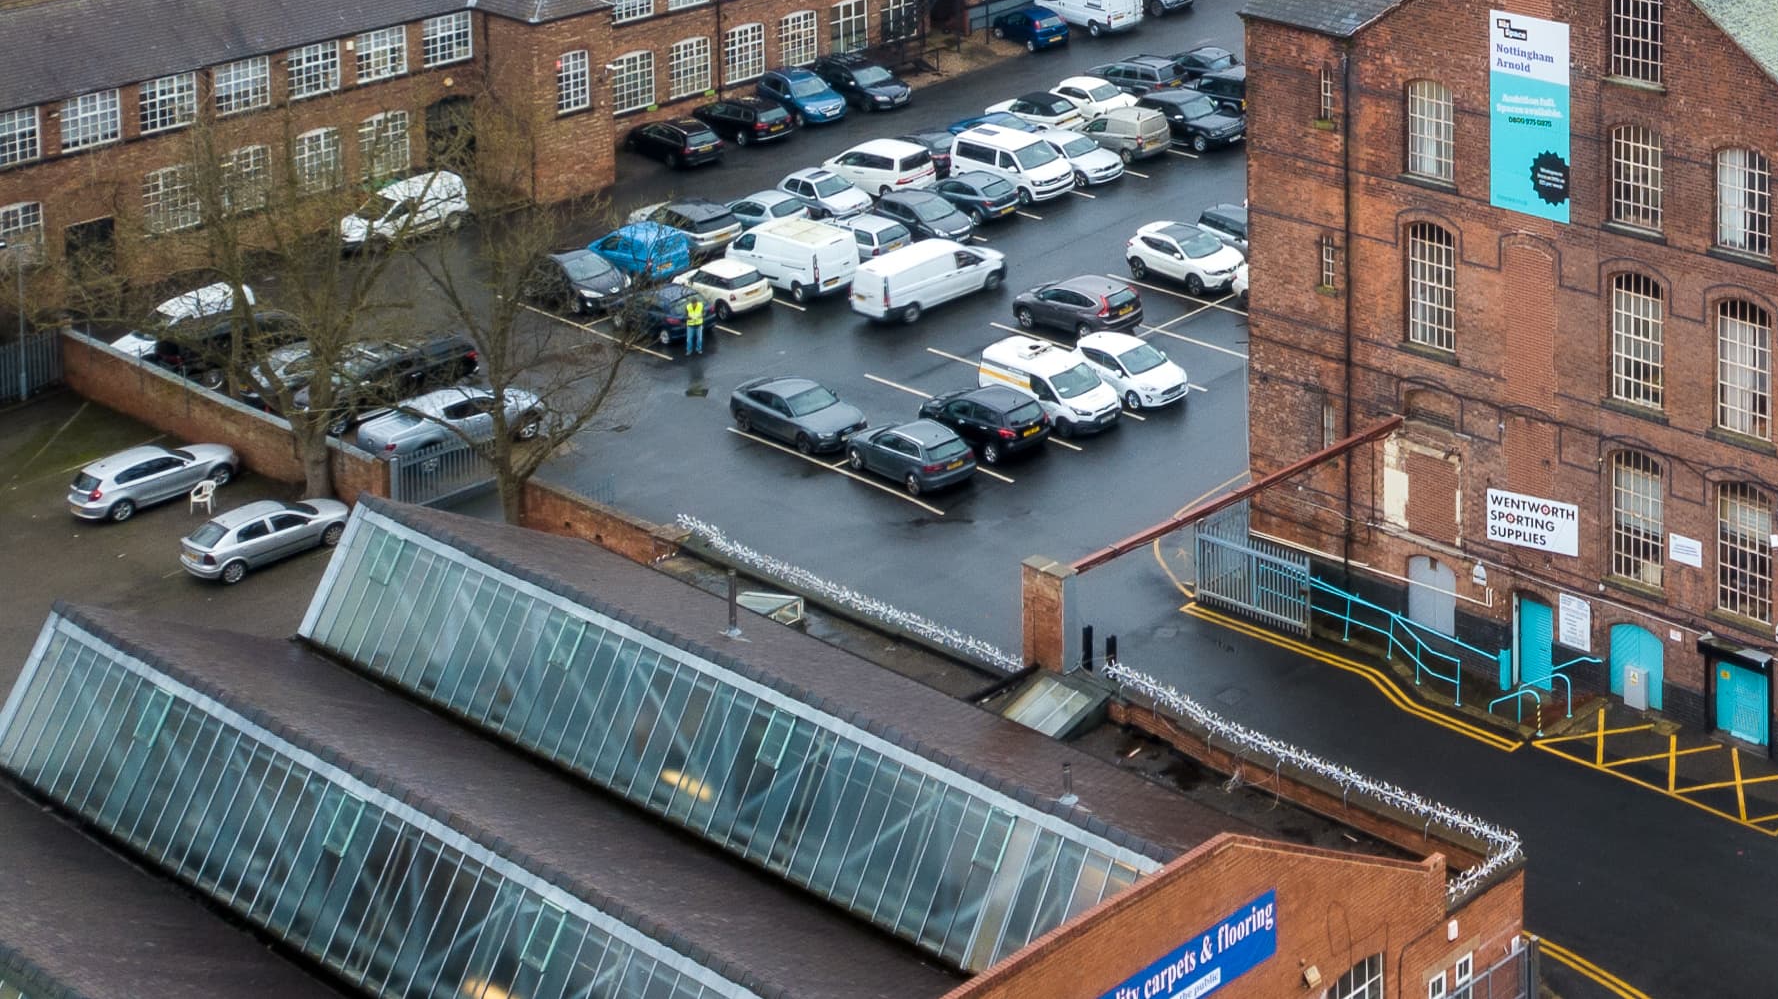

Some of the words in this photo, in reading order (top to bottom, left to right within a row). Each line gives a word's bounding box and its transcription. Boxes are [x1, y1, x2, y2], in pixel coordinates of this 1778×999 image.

[1496, 43, 1554, 63] Nottingham
[1497, 58, 1531, 72] Arnold
[1490, 494, 1575, 521] WENTWORTH
[1490, 510, 1555, 532] SPORTING
[1490, 525, 1547, 546] SUPPLIES
[1144, 948, 1197, 996] carpets
[1200, 935, 1214, 964] &
[1217, 902, 1275, 954] flooring
[1194, 971, 1219, 995] public
